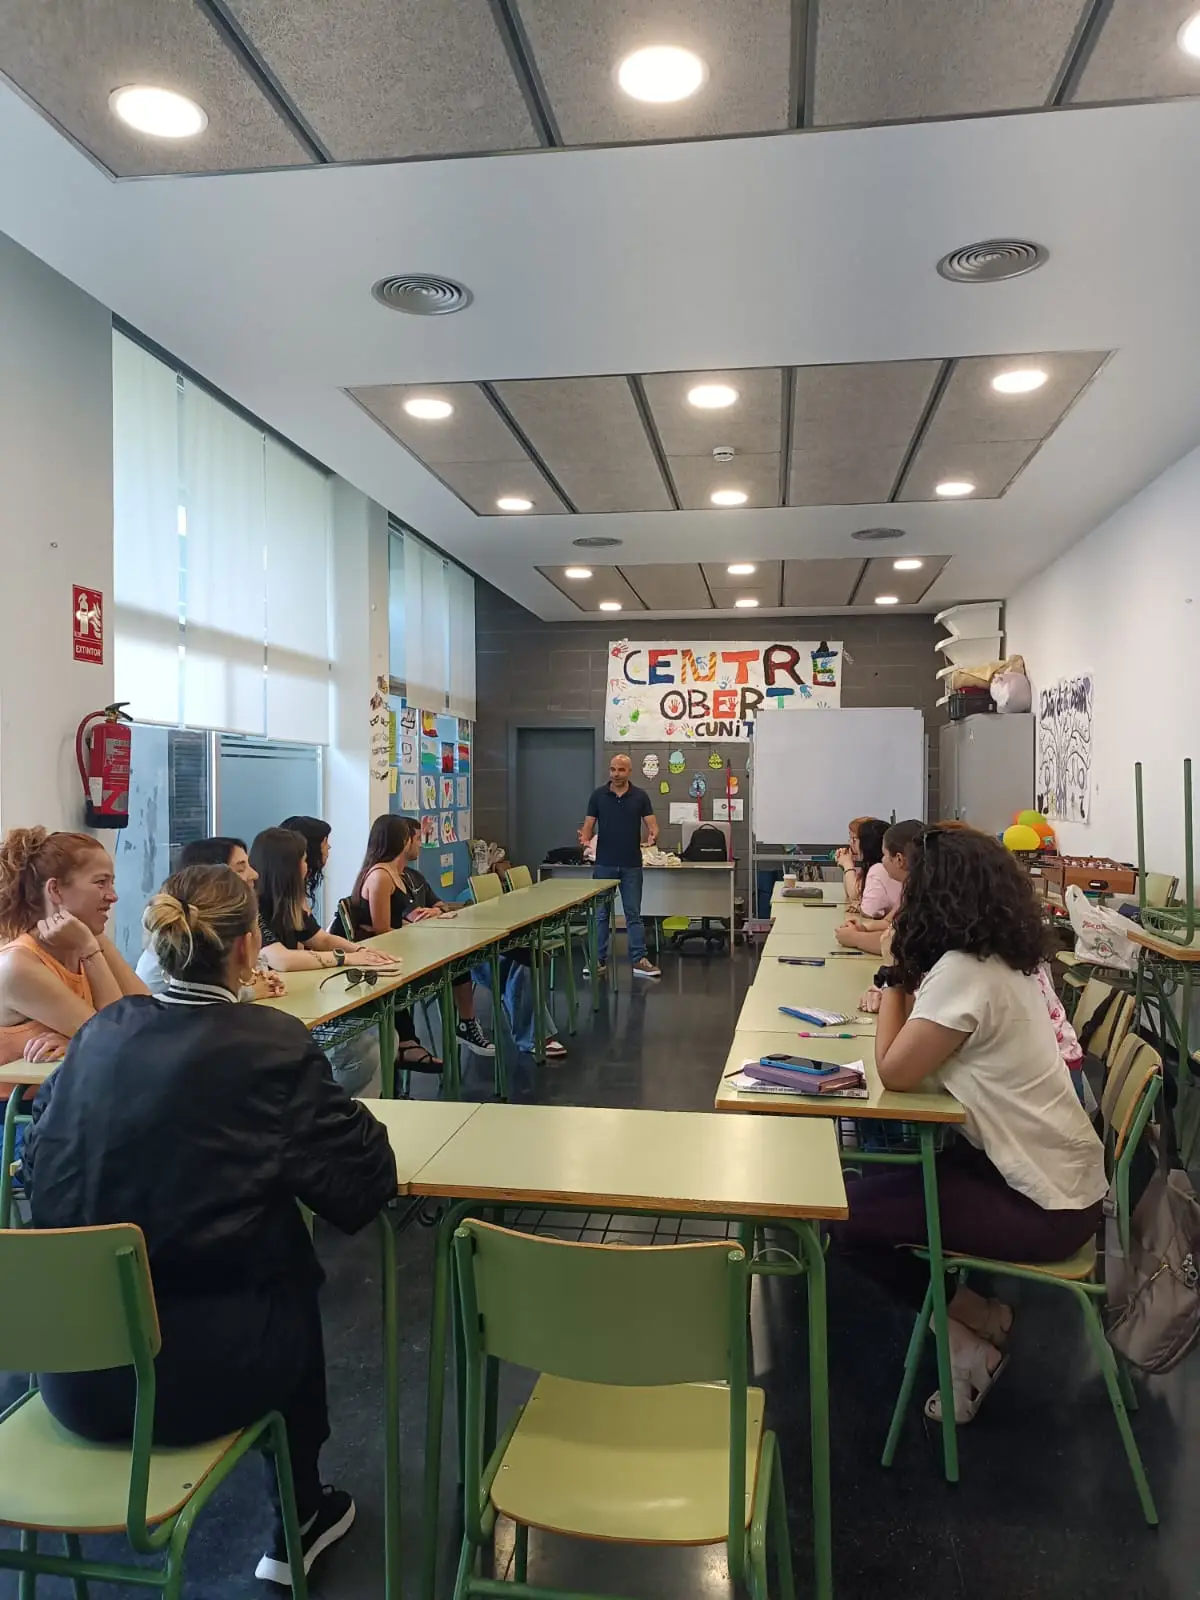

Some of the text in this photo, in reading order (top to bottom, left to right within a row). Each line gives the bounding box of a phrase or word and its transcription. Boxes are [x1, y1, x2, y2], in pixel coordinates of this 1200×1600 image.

[75, 644, 102, 657] EXTINTOR
[623, 643, 839, 687] CENTRE
[659, 686, 796, 721] OBERT
